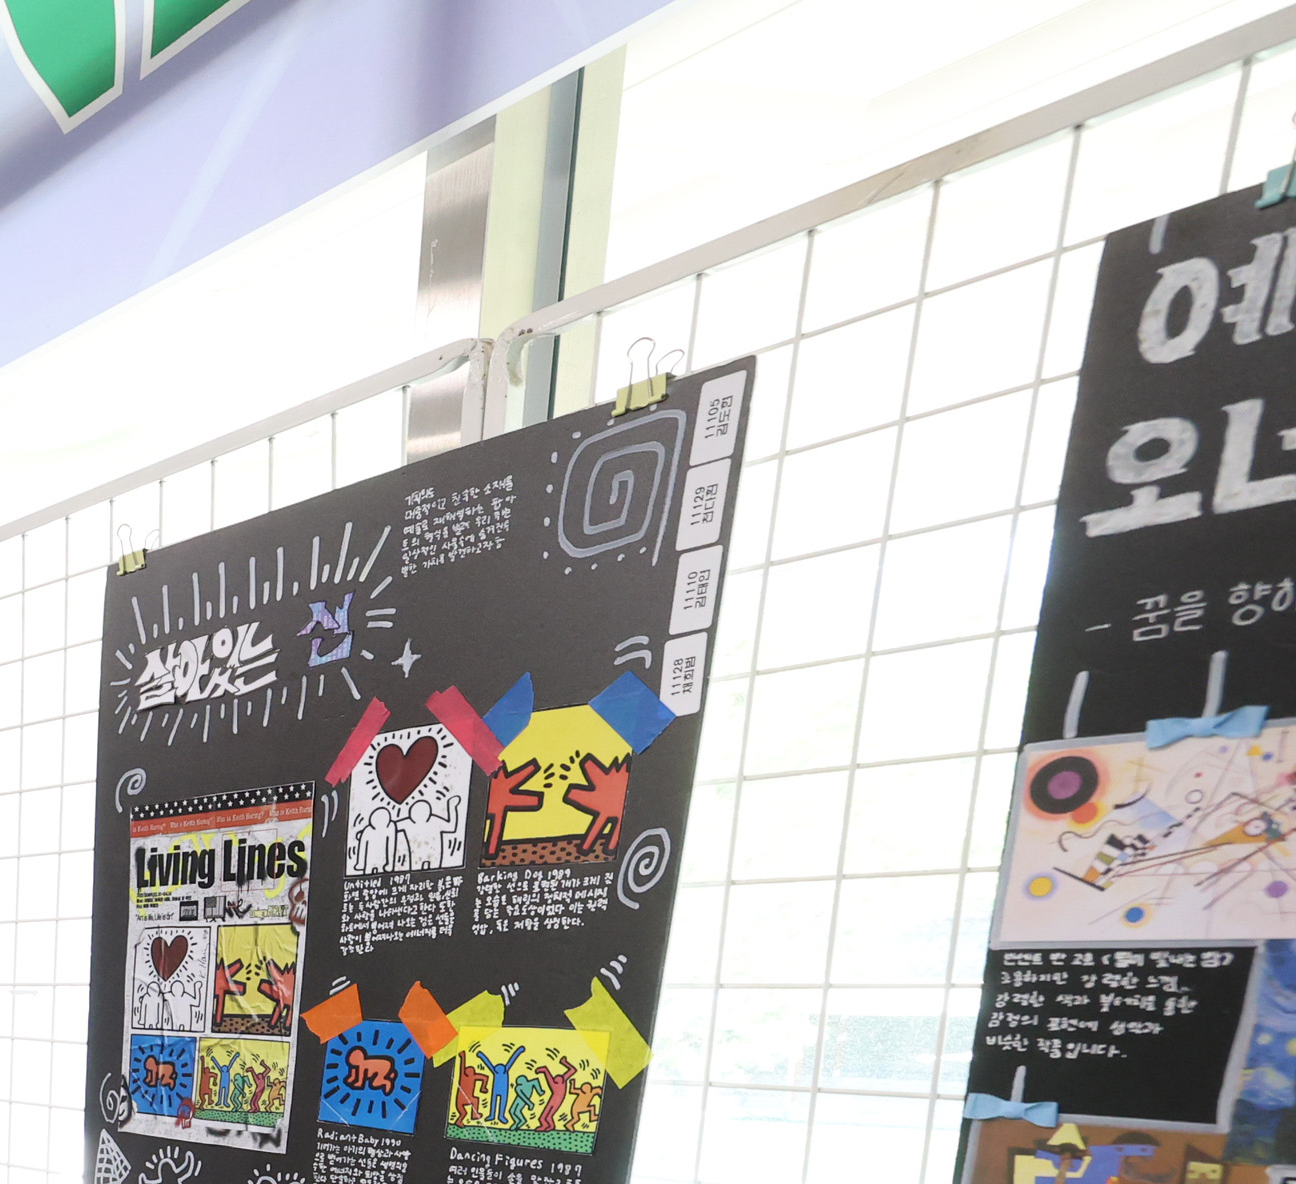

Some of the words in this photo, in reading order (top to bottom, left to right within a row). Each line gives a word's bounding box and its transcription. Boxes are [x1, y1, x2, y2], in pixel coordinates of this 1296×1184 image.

[705, 399, 720, 438] 11105
[691, 487, 705, 525] 11129
[684, 572, 698, 609] 11110
[1132, 590, 1206, 641] 꿈을
[135, 622, 279, 712] 살아있는
[671, 658, 684, 696] 11128
[136, 844, 215, 889] Living
[223, 839, 307, 883] Lines
[478, 871, 518, 884] Barking
[525, 869, 543, 881] Dog
[548, 869, 571, 880] 1989
[344, 878, 381, 890] Untitled
[450, 1147, 490, 1168] Dancing
[495, 1154, 543, 1170] Figures
